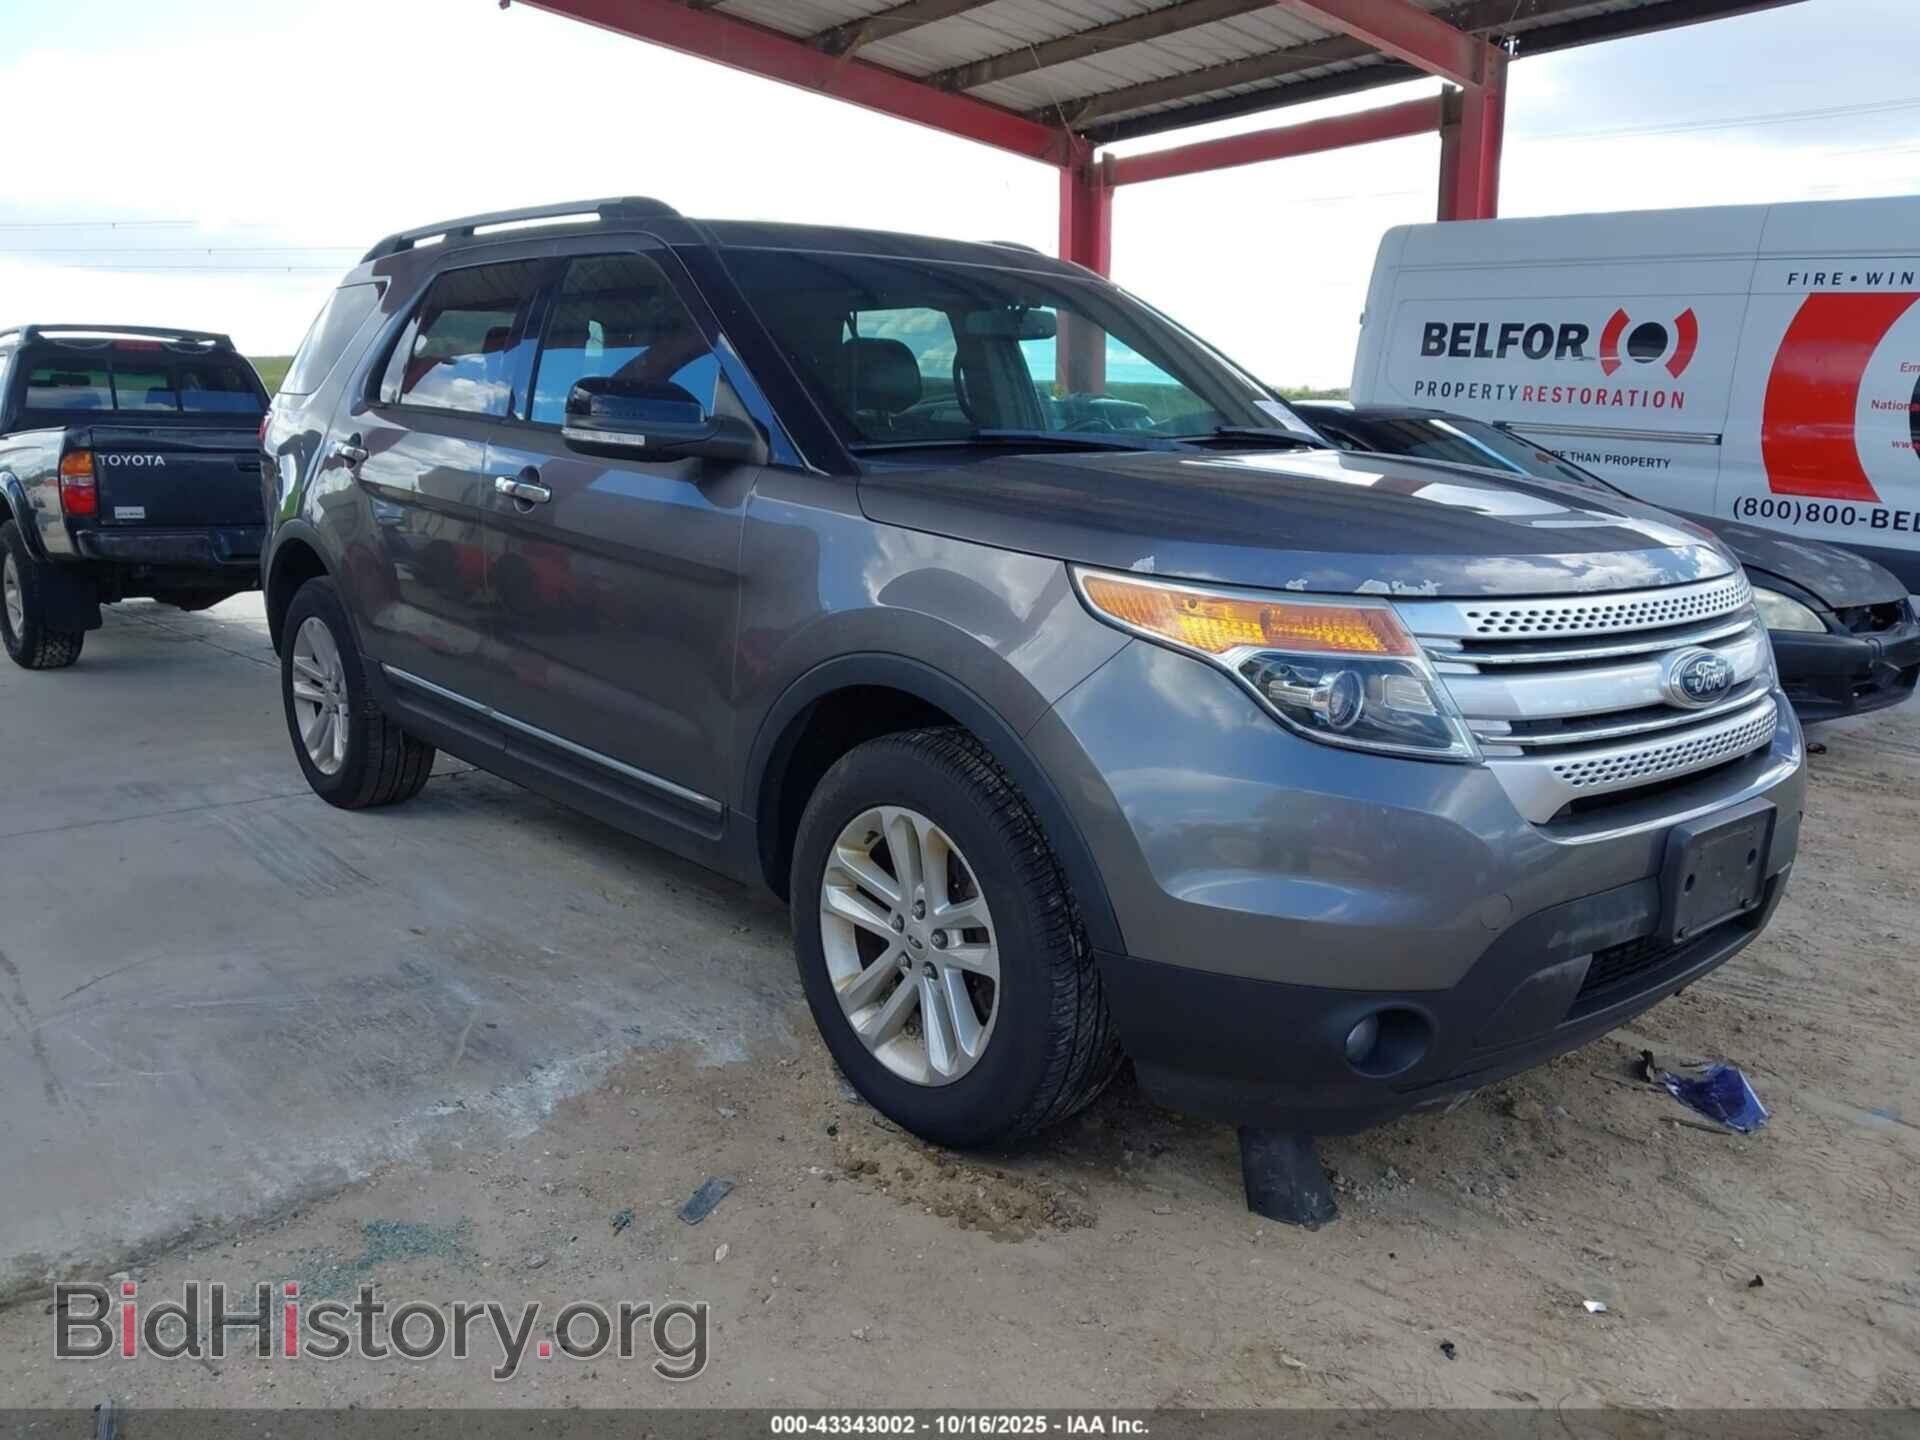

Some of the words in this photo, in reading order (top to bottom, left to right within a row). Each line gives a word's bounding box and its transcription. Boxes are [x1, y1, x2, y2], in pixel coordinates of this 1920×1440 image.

[1420, 321, 1590, 361] BELFOR
[98, 454, 167, 467] TOYOTA
[1570, 451, 1600, 464] THAN
[1604, 454, 1672, 469] PROPERTY
[1695, 660, 1727, 693] Ford
